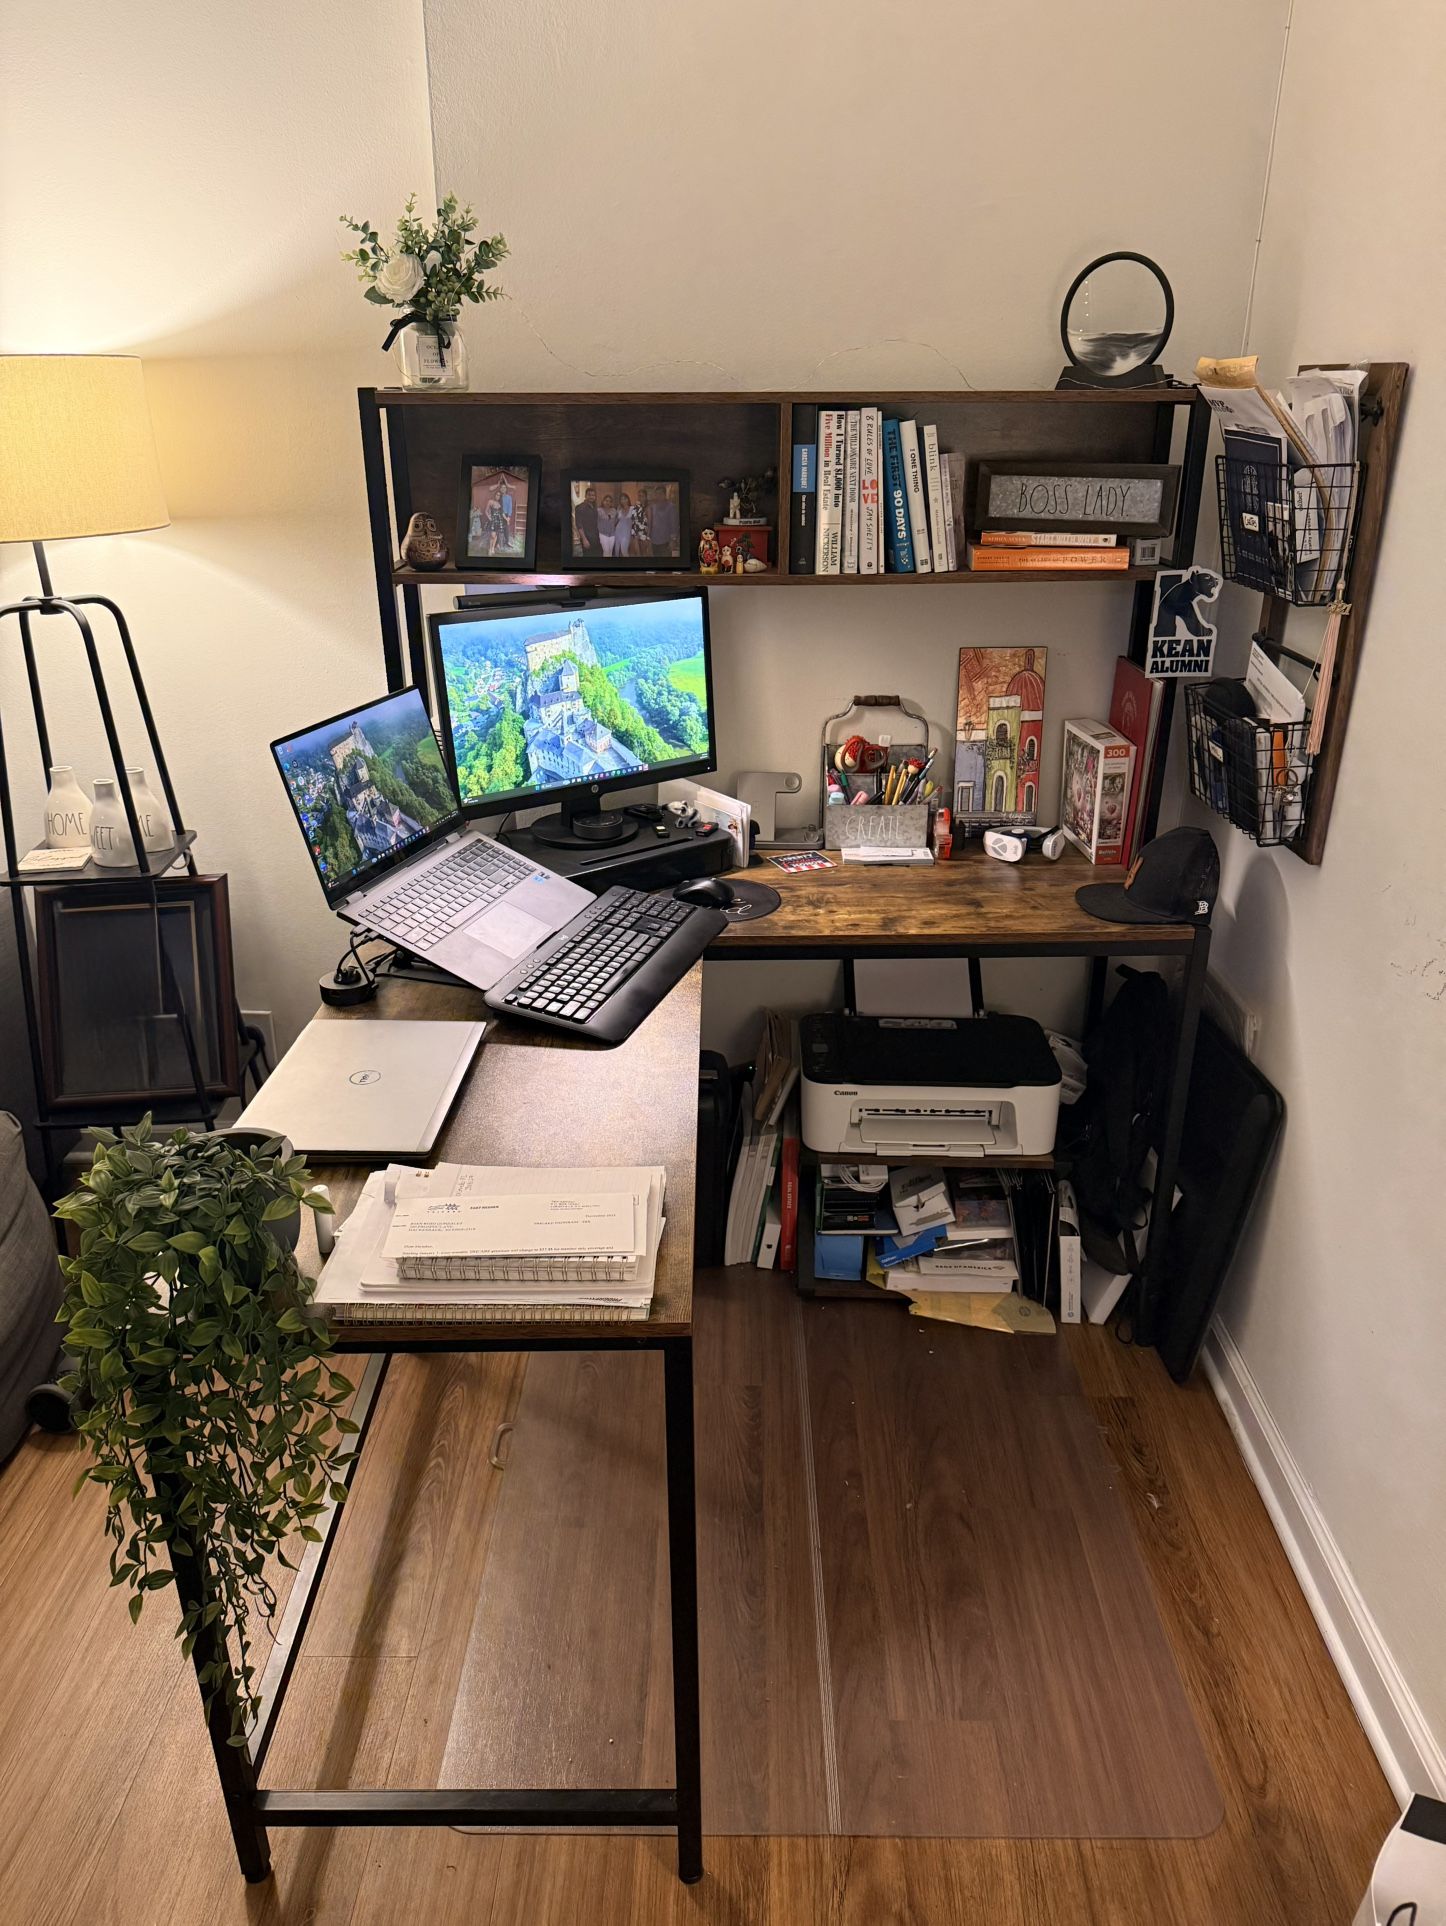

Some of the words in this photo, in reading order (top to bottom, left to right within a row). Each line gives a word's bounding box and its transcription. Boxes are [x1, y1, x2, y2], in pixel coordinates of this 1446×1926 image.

[824, 413, 833, 430] Five
[836, 413, 844, 432] How
[824, 432, 832, 458] Million
[887, 428, 898, 453] THE
[835, 439, 844, 466] Turned
[867, 448, 873, 456] OF
[927, 443, 938, 472] blink
[824, 459, 832, 468] in
[866, 458, 874, 475] LOVE
[890, 455, 902, 488] FIRST
[823, 470, 832, 487] Real
[833, 468, 843, 491] $1,000
[911, 470, 919, 493] THING
[822, 489, 831, 511] Estate
[834, 492, 842, 508] into
[893, 489, 904, 507] 90
[1018, 482, 1072, 515] BOSS
[896, 508, 907, 539] DAYS
[822, 528, 830, 573] NICKERSON
[830, 532, 838, 566] WILLIAM
[1062, 556, 1108, 564] POWER
[1151, 639, 1213, 658] KEAN
[1149, 659, 1209, 674] ALUMNI
[1106, 749, 1126, 757] 300
[48, 812, 87, 836] HOME
[845, 815, 904, 841] CREATE
